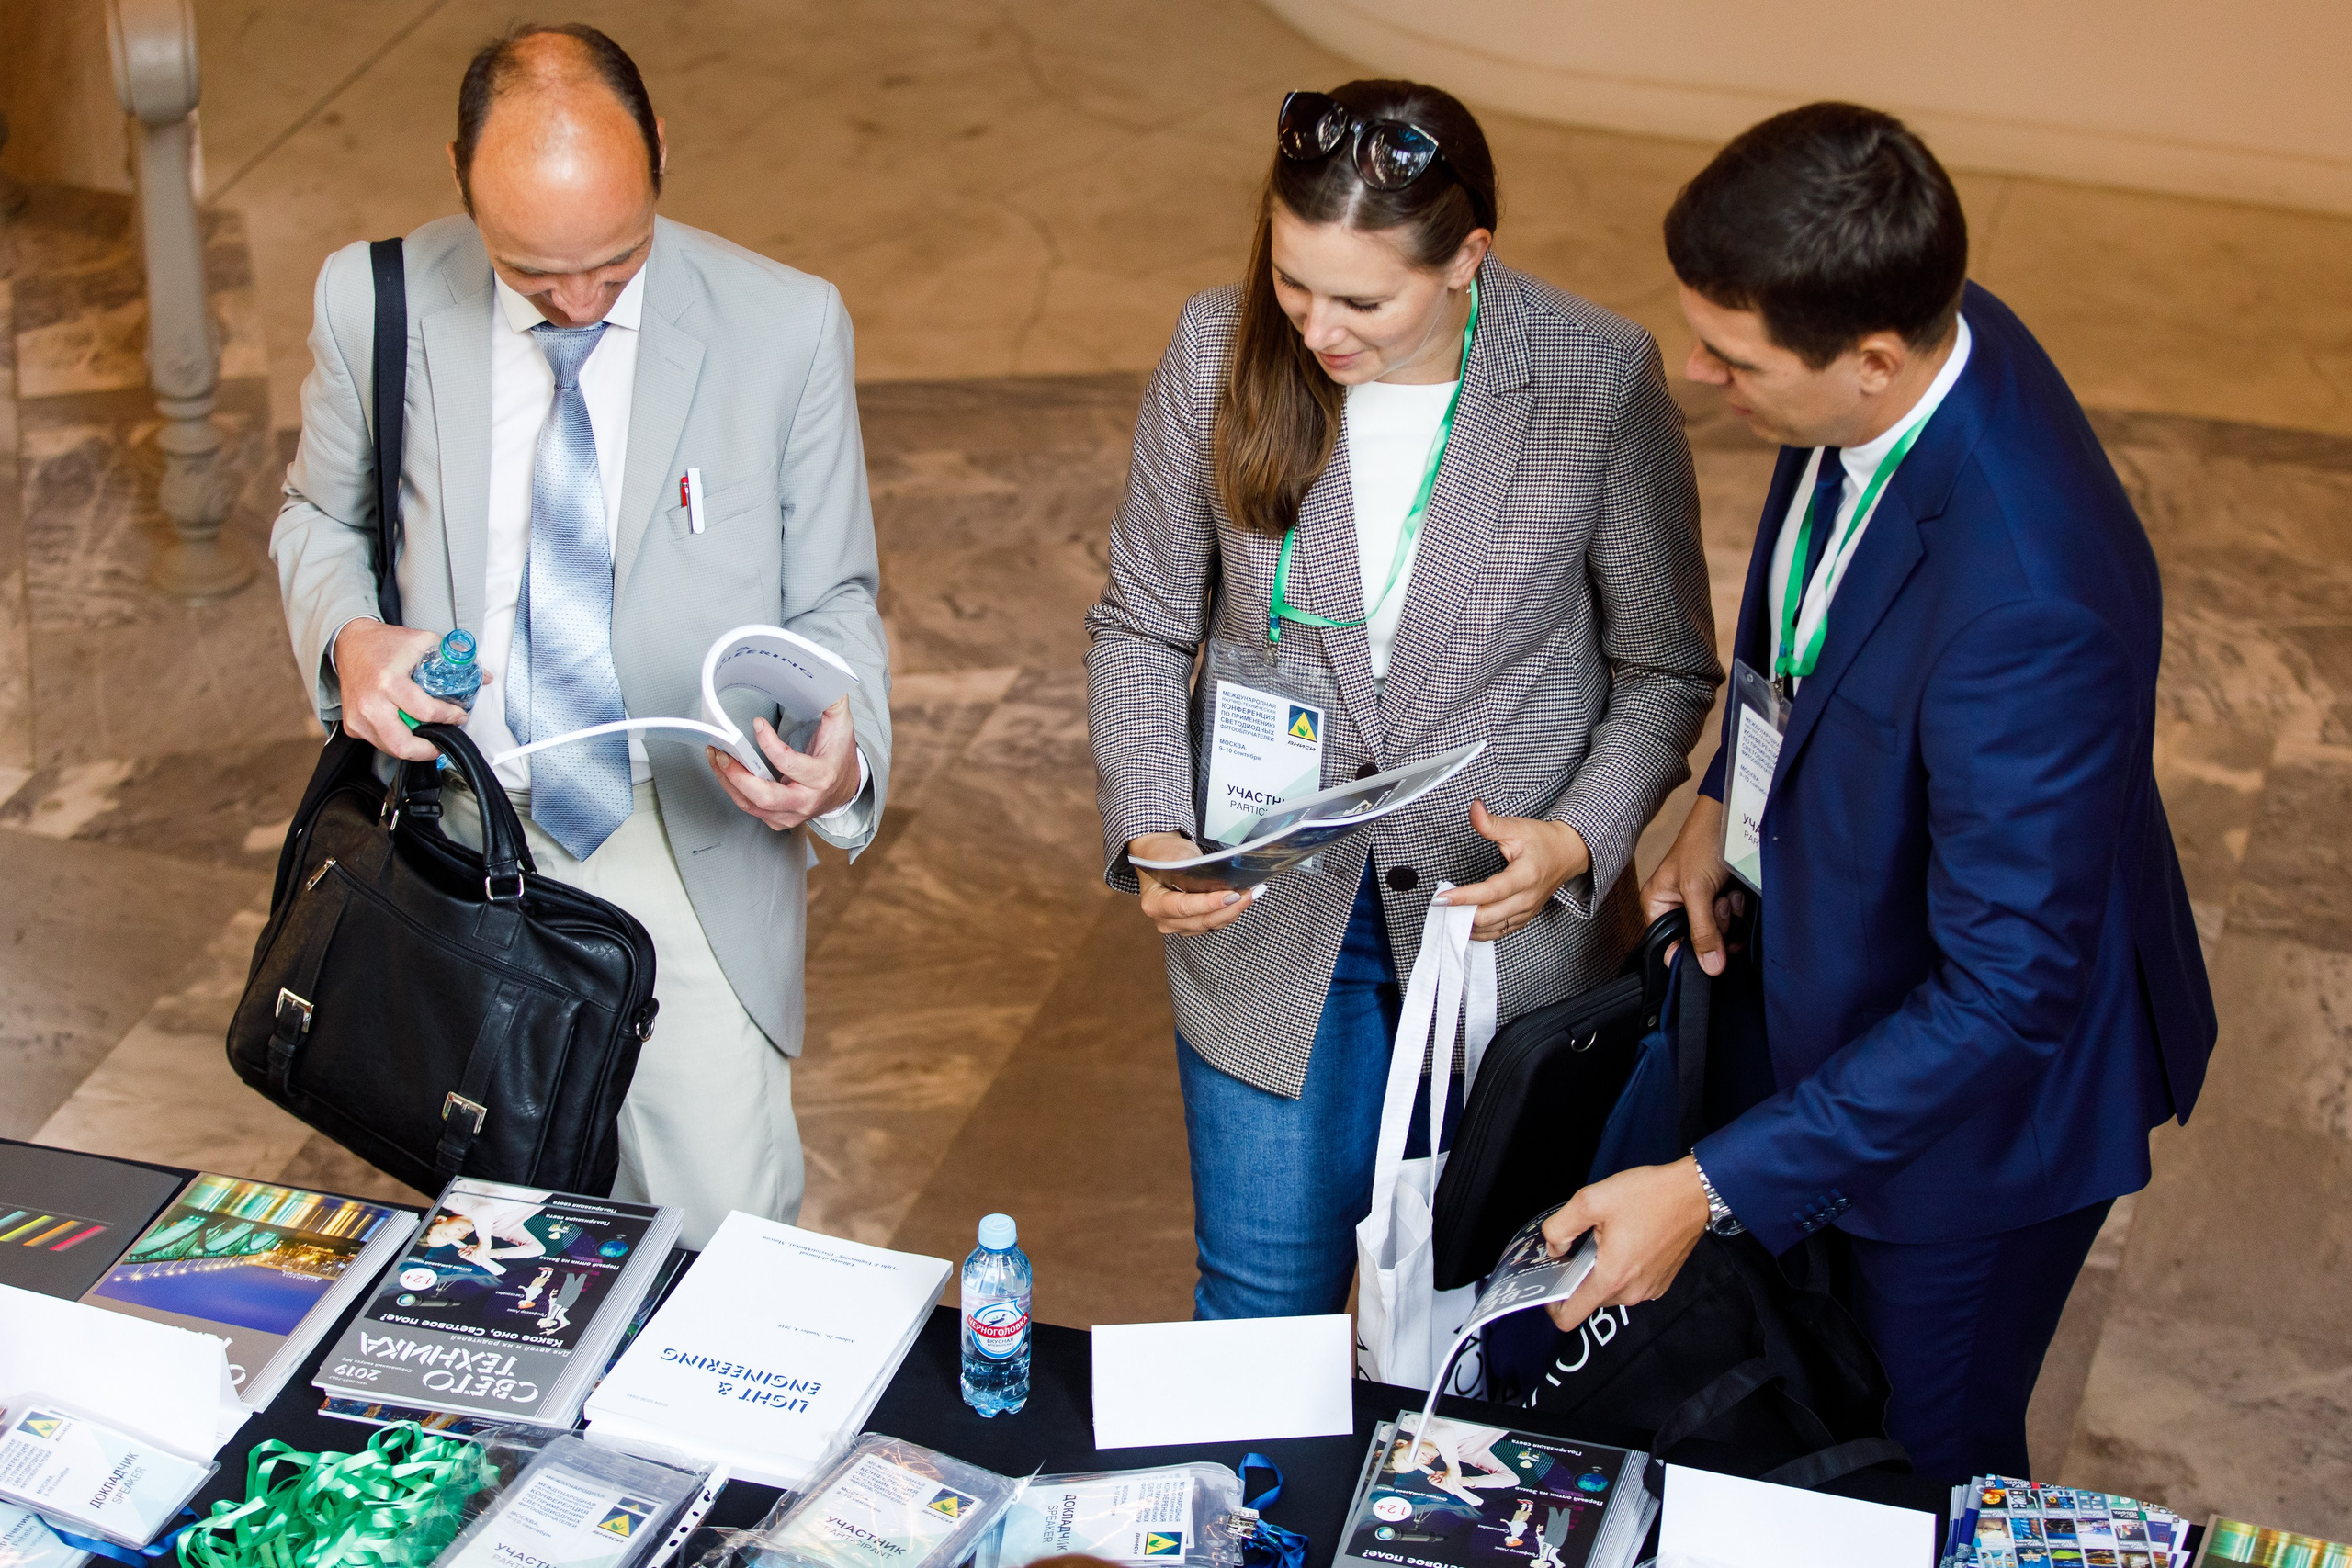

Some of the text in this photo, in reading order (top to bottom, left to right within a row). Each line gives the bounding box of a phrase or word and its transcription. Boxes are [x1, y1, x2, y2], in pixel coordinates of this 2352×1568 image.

[1221, 696, 1276, 715] НАУЧНО-ТЕХНИЧЕСКАЯ
[1222, 690, 1277, 709] МЕЖДУНАРОДНАЯ
[1220, 709, 1275, 728] ПО ПРИМЕНЕНИЮ
[1221, 702, 1276, 722] КОНФЕРЕНЦИЯ
[1219, 724, 1275, 742] ФИТООБЛУЧАТЕЛЕЙ
[1220, 716, 1275, 736] СВЕТОДИОДНЫХ
[1287, 740, 1316, 751] ВНИСИ
[1233, 750, 1261, 761] сентября
[1227, 784, 1284, 806] УЧАСТН
[1229, 800, 1269, 816] PARTIC
[552, 1200, 617, 1214] Поляризация света
[564, 1216, 611, 1226] Поляризация
[538, 1255, 560, 1263] Земле
[592, 1262, 620, 1270] Первый
[403, 1273, 432, 1285] 12+
[379, 1313, 564, 1348] Какое оно, Световое поле?
[967, 1315, 1029, 1337] ЧЕРНОГОЛОВКА
[449, 1335, 501, 1347] родителей
[523, 1345, 552, 1353] детей
[360, 1331, 518, 1377] ТЕХНИКА
[553, 1349, 572, 1358] Для
[334, 1363, 382, 1382] 2019
[659, 1348, 822, 1396] ENGINEERING
[422, 1369, 539, 1403] СВЕТО
[718, 1381, 810, 1414] LIGHT &
[1532, 1443, 1582, 1456] Поляризация
[89, 1450, 140, 1509] ДОКЛАДЧИК
[111, 1466, 147, 1505] SPEAKER
[545, 1474, 606, 1499] МЕЖДУНАРОДНАЯ
[537, 1481, 597, 1507] МЕЖДУНАРОДНАЯ
[1426, 1494, 1448, 1502] Оптика
[1515, 1486, 1538, 1495] Земле
[526, 1493, 586, 1520] ПО ПРИМЕНЕНИЮ
[529, 1488, 591, 1516] КОНФЕРЕНЦИЯ
[1377, 1504, 1407, 1516] 12+
[1573, 1495, 1603, 1506] Первый
[517, 1501, 578, 1529] ФИТООБЛУЧАТЕЛЕЙ
[522, 1496, 582, 1525] СВЕТОДИОДНЫХ
[921, 1509, 953, 1524] ВНИСИ
[3, 1514, 33, 1540] Пчелин
[1042, 1505, 1059, 1544] SPEAKER
[1056, 1493, 1077, 1552] ДОКЛАДЧИК
[592, 1529, 625, 1544] ВНИСИ
[823, 1525, 894, 1560] PARTICIPANT
[825, 1516, 907, 1556] УЧАСТНИК
[1133, 1532, 1141, 1555] ВНИСИ
[1362, 1549, 1404, 1562] поле?
